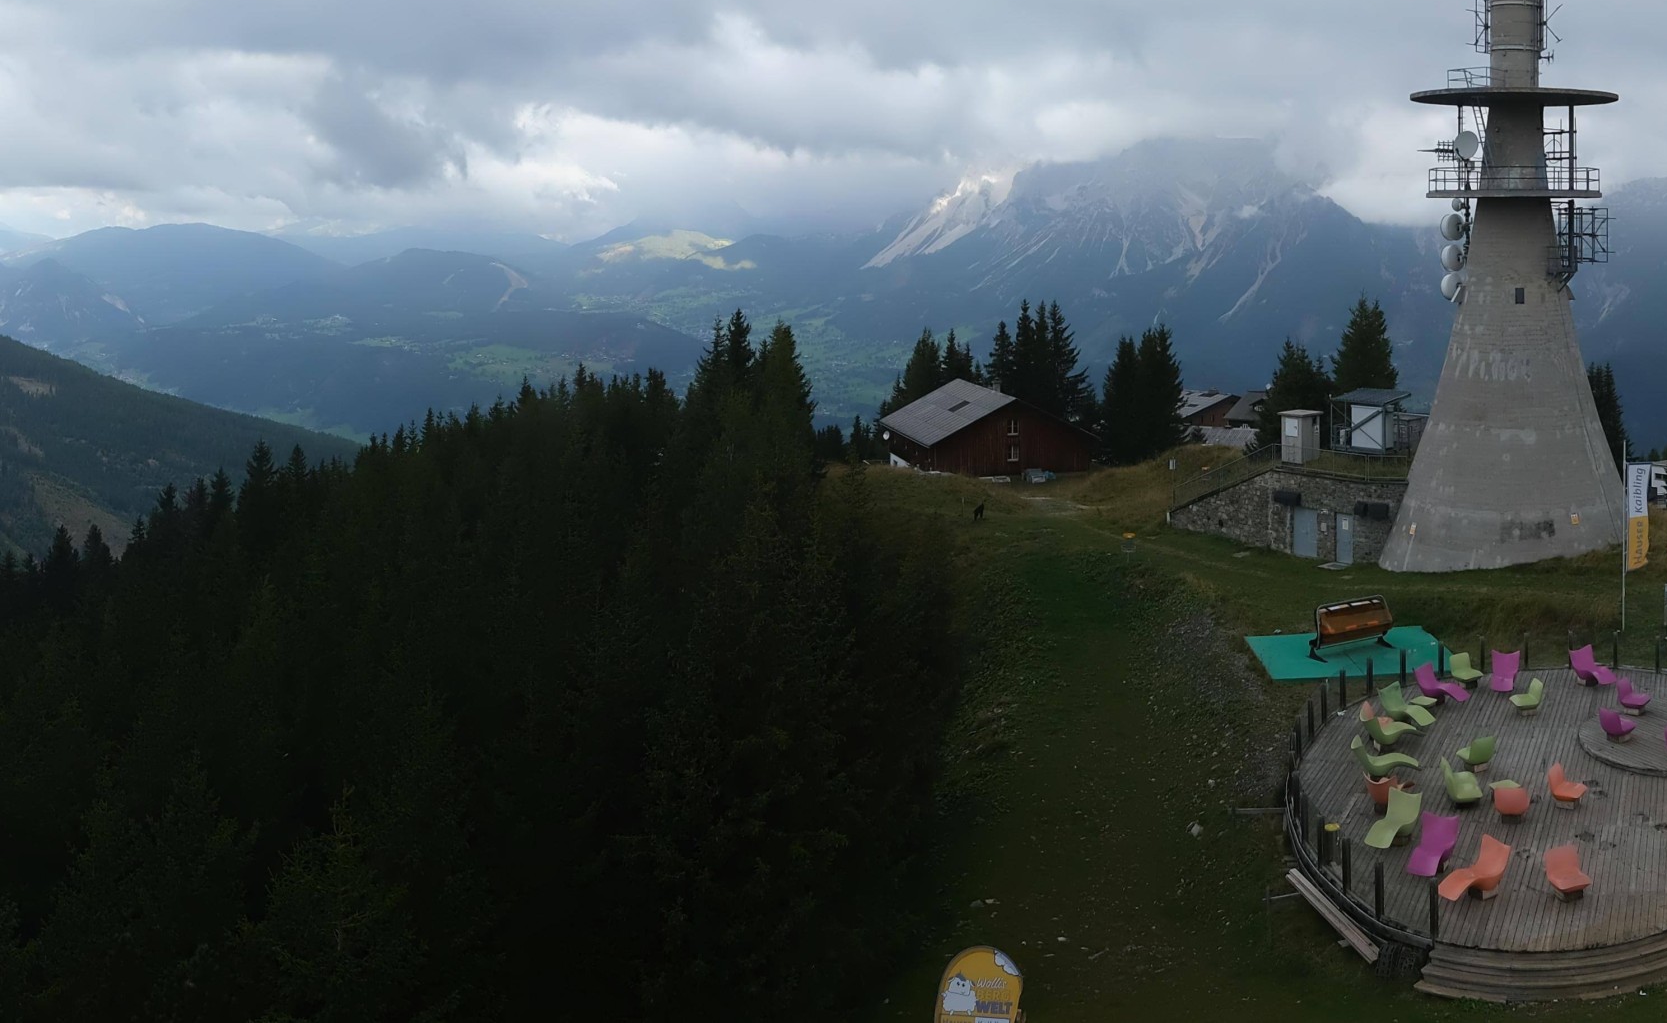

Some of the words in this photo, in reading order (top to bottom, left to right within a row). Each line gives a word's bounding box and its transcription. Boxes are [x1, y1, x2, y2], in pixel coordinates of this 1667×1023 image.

[1631, 467, 1646, 514] Kaibling
[1634, 521, 1643, 565] HAUSER
[975, 1000, 1013, 1014] WELT
[976, 990, 1010, 1001] BERG
